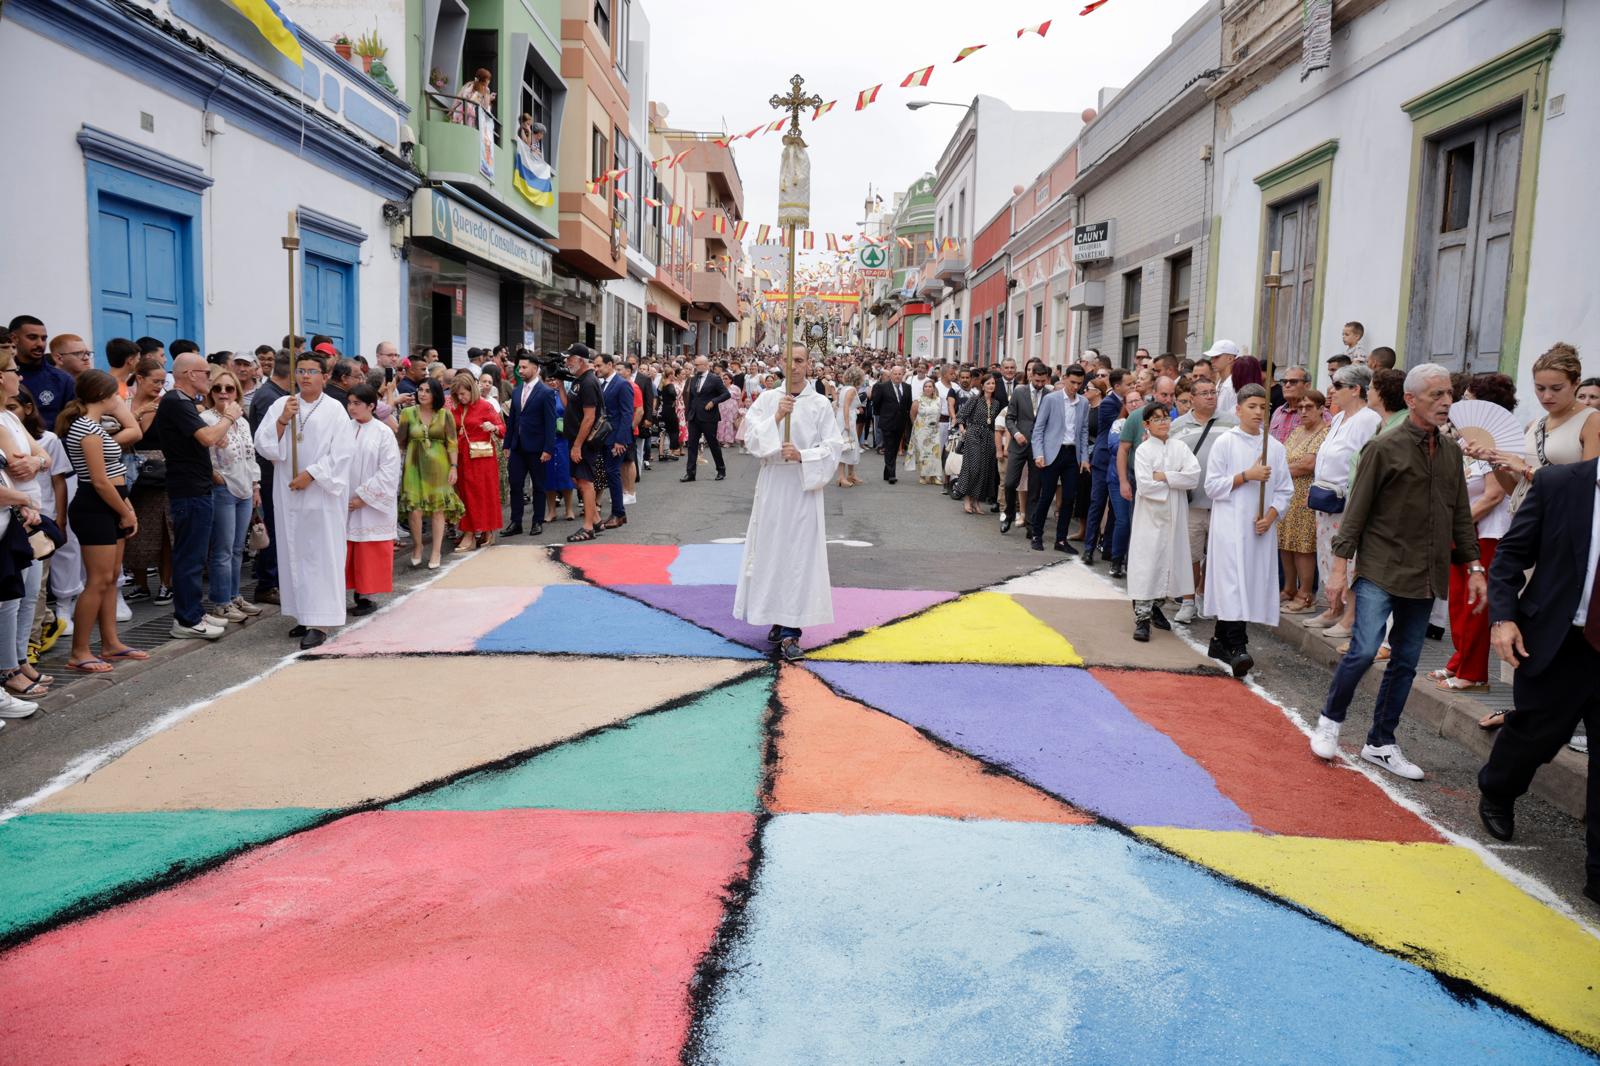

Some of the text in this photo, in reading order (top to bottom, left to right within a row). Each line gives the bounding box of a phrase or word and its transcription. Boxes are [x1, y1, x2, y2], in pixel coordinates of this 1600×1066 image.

[436, 196, 447, 239] Q
[452, 207, 488, 241] Quevedo
[1077, 230, 1104, 243] CAUNY
